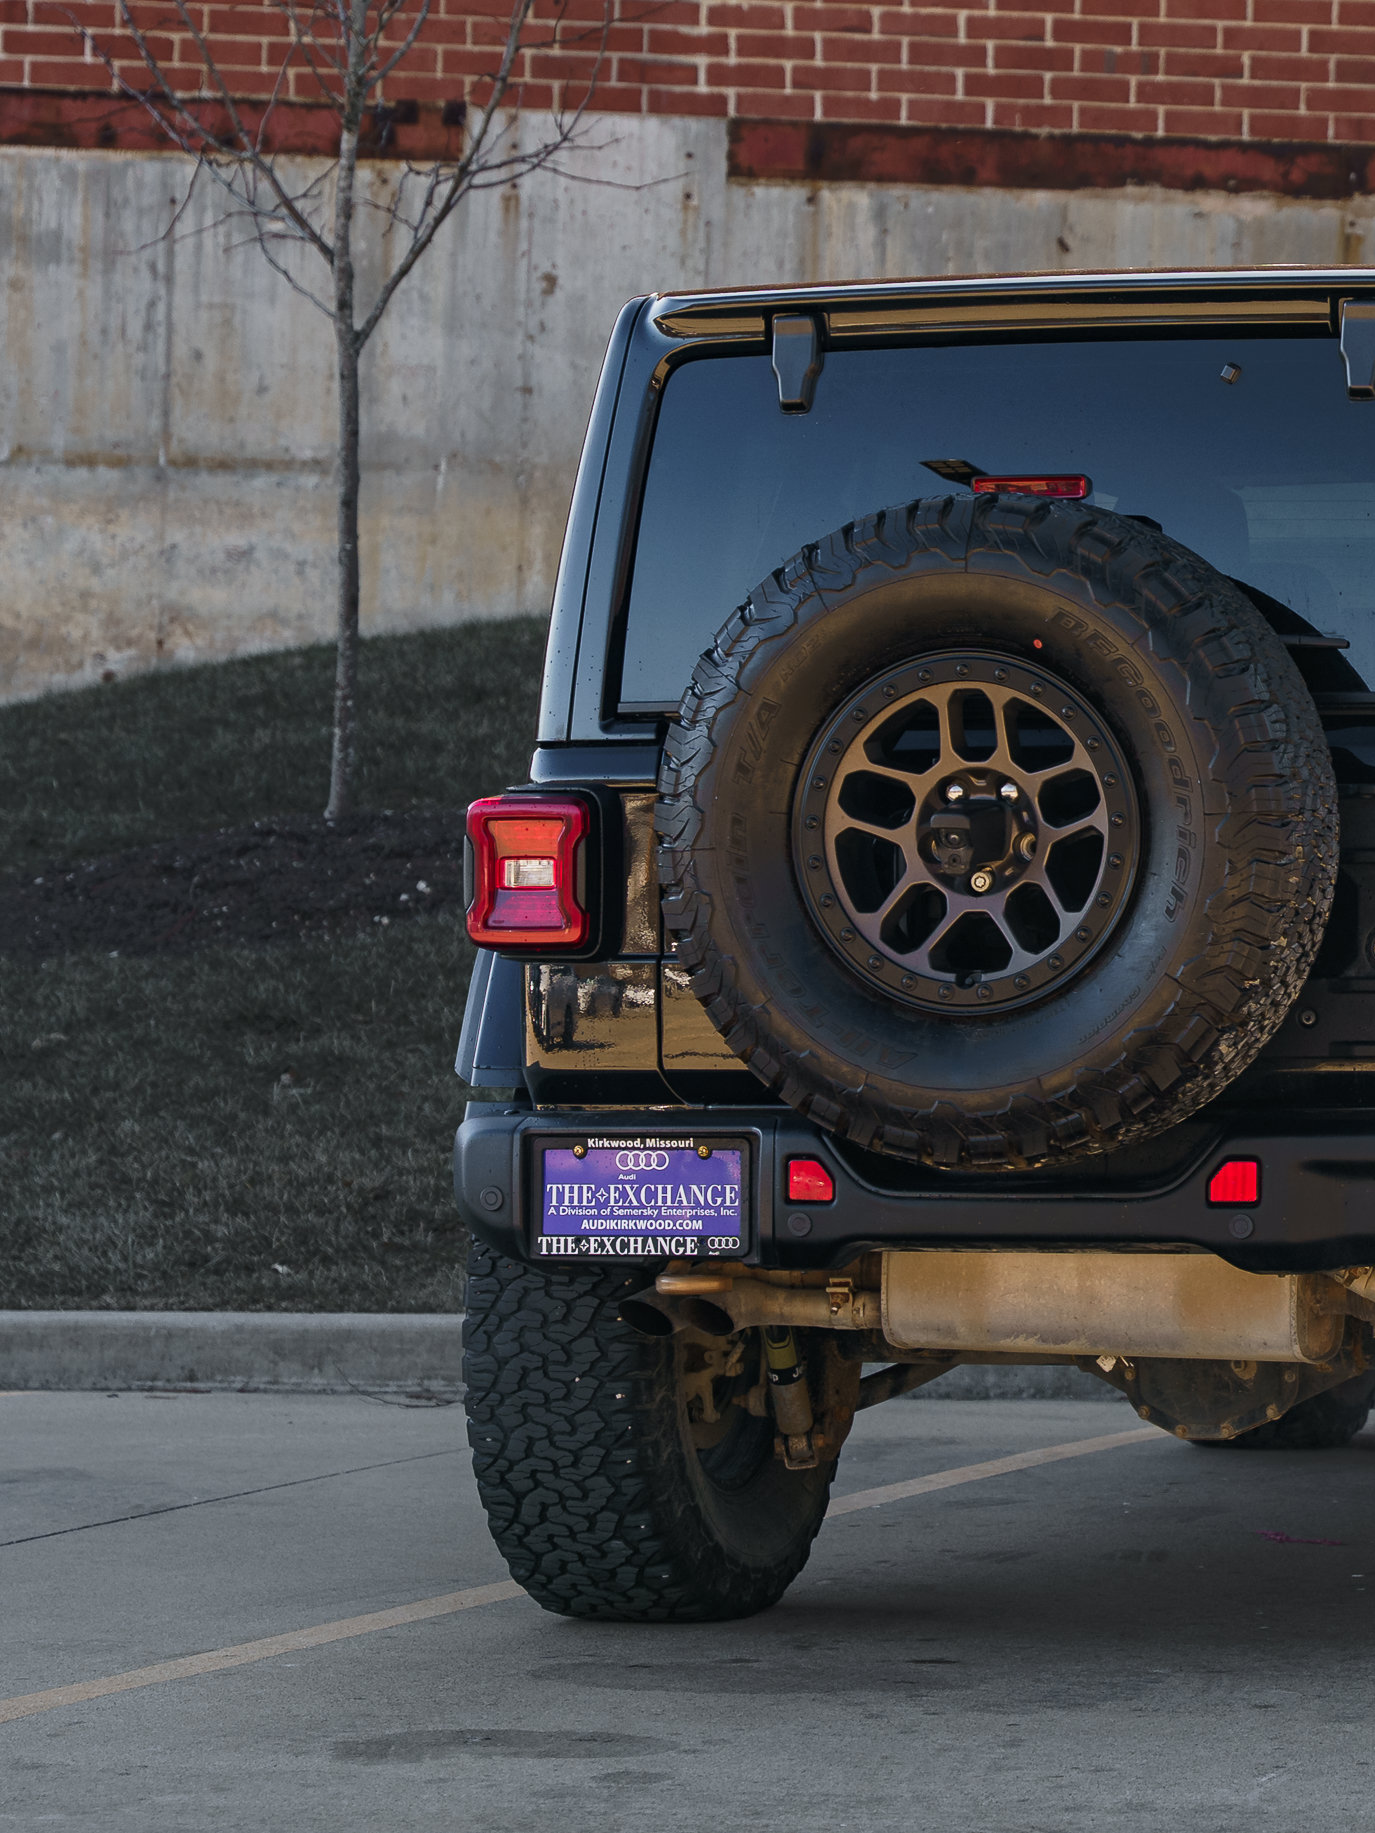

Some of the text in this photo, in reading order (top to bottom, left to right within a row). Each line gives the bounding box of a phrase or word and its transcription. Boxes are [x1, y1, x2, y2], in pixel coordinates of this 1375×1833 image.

[732, 697, 783, 785] T/A
[1050, 608, 1198, 923] BFGoodrich
[587, 1138, 694, 1149] Kirkwood, Missouri
[546, 1184, 739, 1206] THE EXCHANGE
[548, 1207, 737, 1217] A Division of Semersky Enterprises, Inc.
[581, 1219, 703, 1230] AUDIKIRKWOOD.COM
[538, 1236, 698, 1255] THE EXCHANGE
